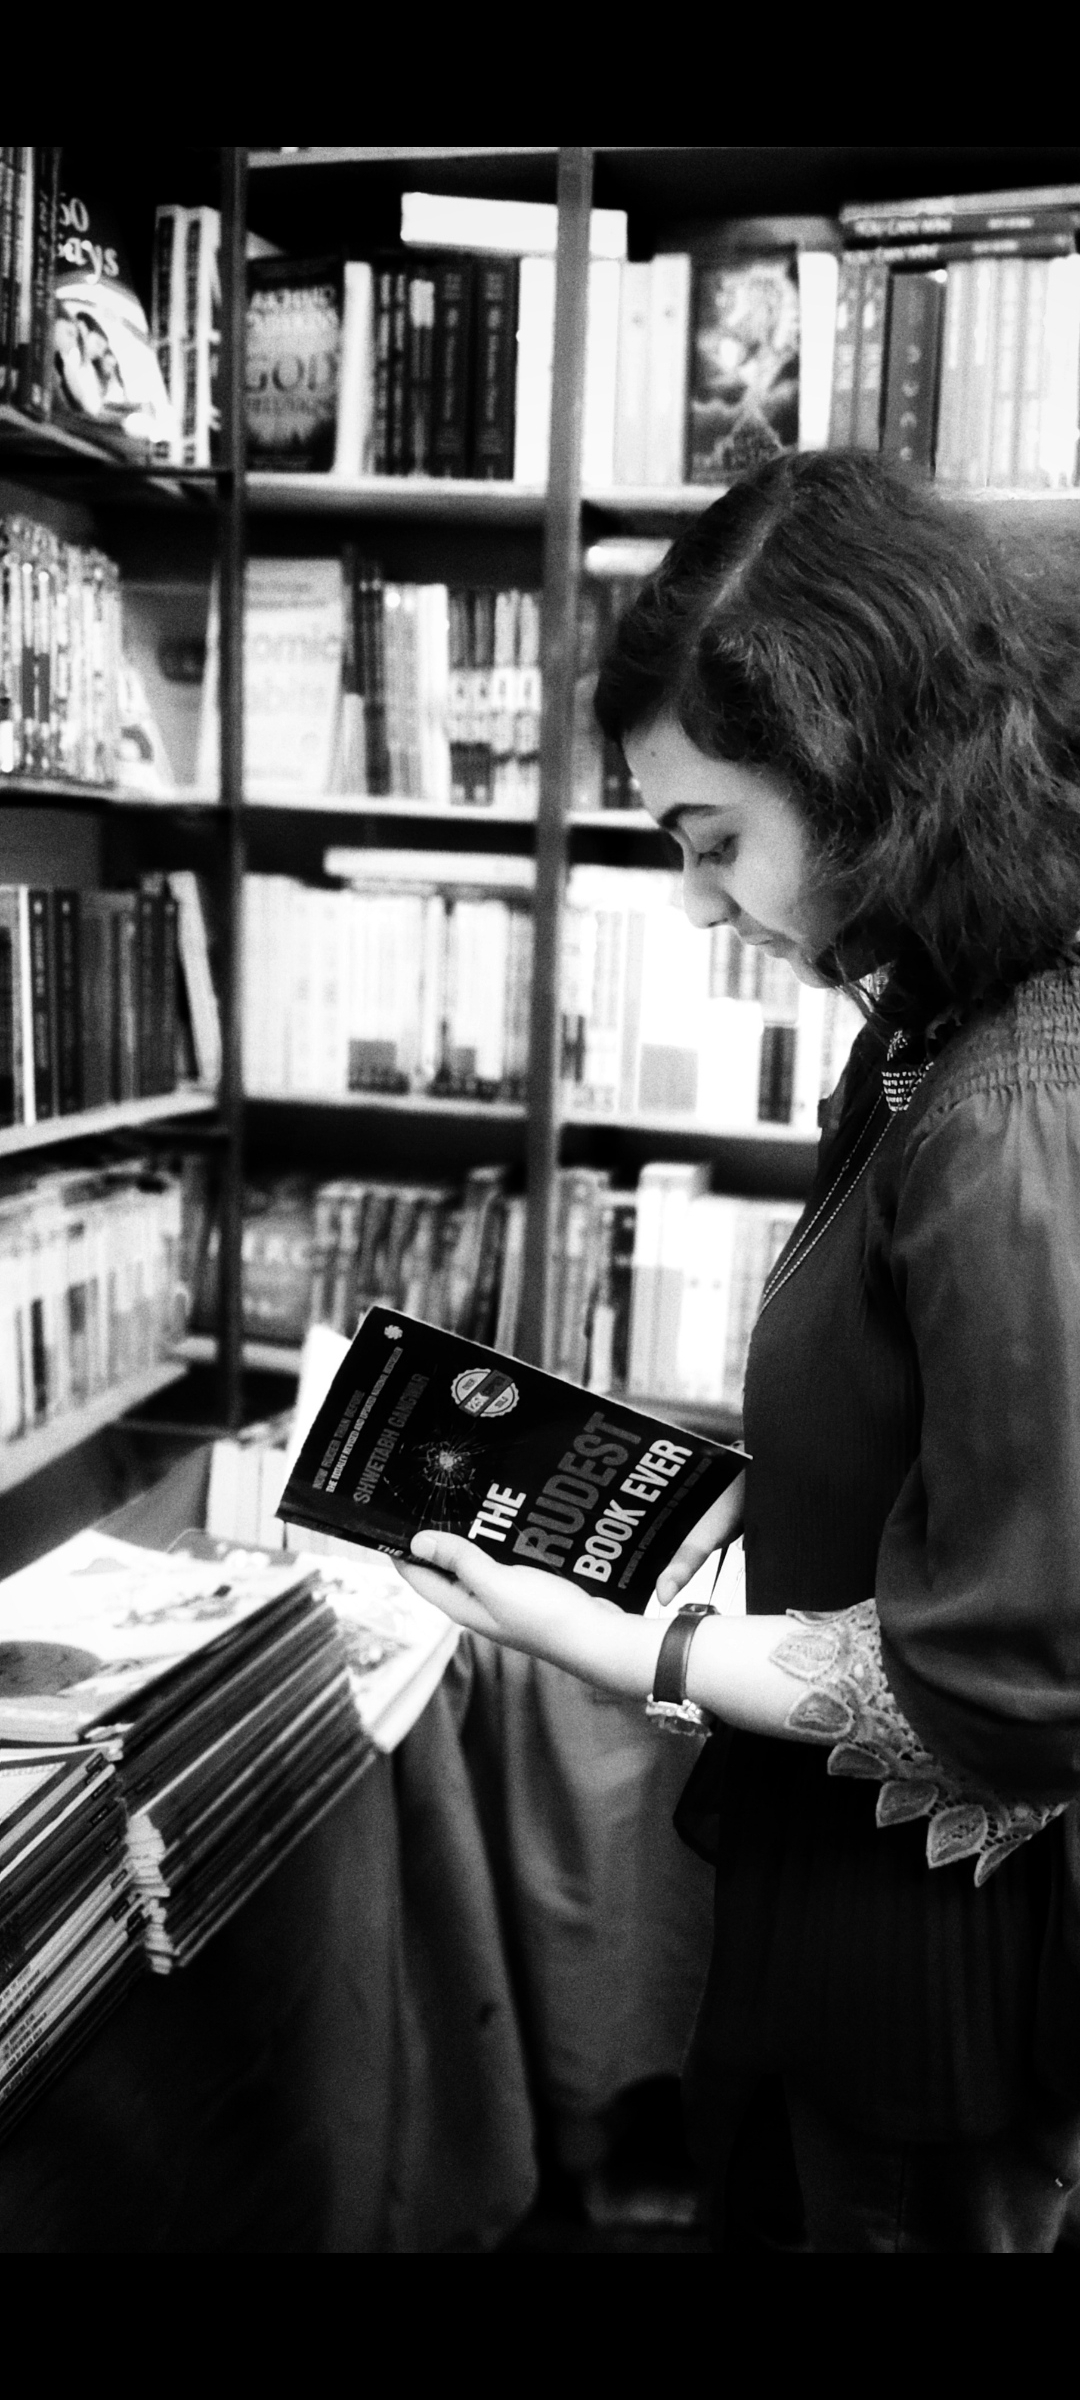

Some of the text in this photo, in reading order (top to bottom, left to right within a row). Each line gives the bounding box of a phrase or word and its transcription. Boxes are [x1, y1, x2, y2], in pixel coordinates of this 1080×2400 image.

[57, 236, 119, 285] ays
[353, 1373, 429, 1503] SHWETABH GANGWAR
[512, 1411, 641, 1568] RUDEST
[468, 1483, 527, 1542] THE
[573, 1499, 646, 1582] BOOK
[620, 1440, 693, 1502] EVER
